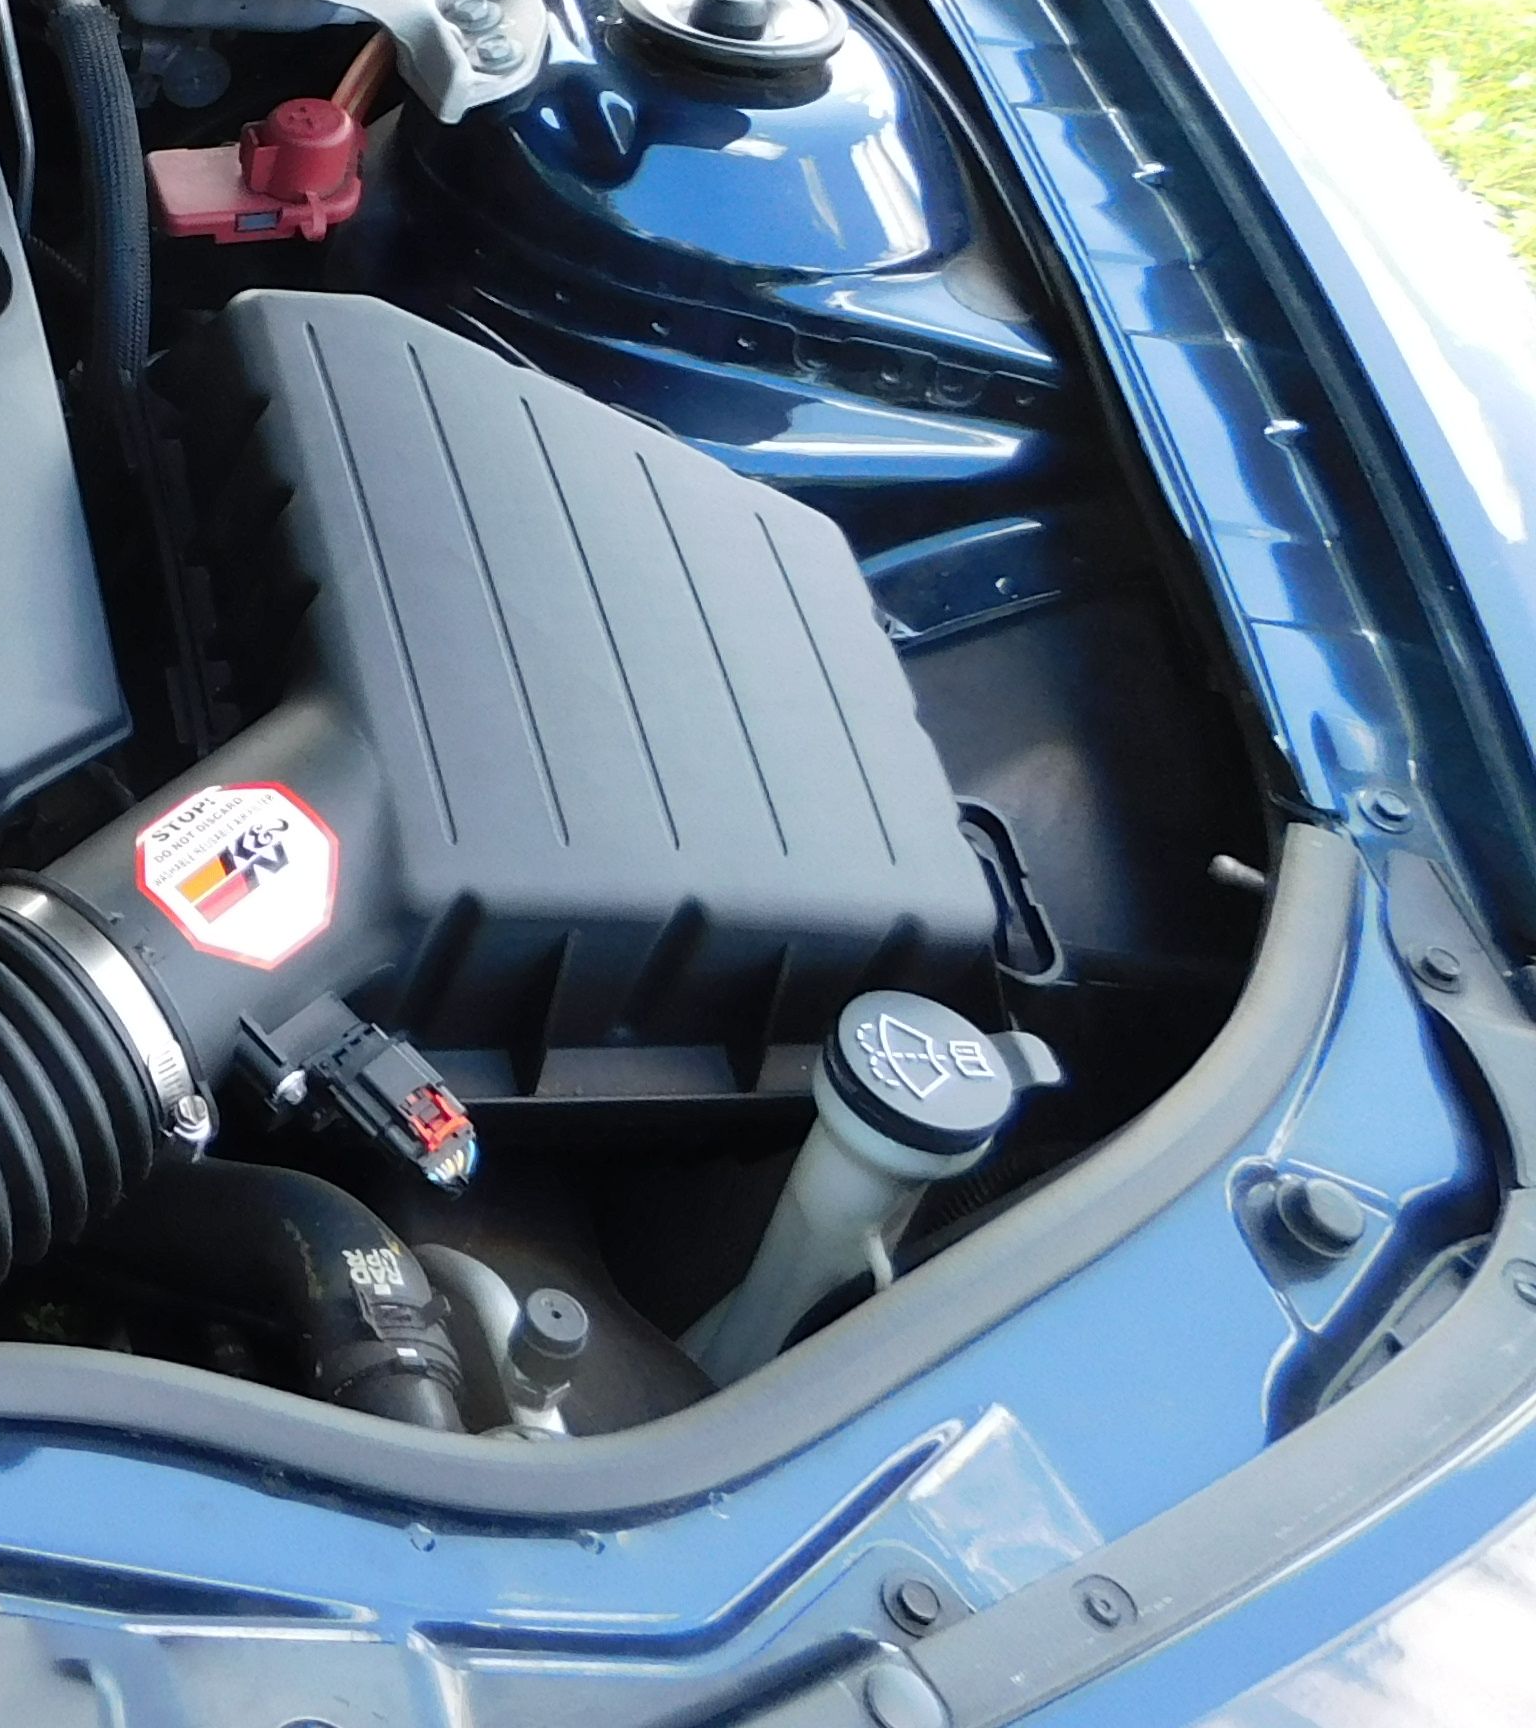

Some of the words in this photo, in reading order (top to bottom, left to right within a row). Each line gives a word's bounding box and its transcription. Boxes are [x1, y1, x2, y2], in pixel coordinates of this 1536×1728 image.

[151, 796, 217, 843] STOP!
[154, 849, 173, 864] DO
[173, 831, 196, 852] NOT
[196, 796, 244, 834] DISCARD
[217, 818, 289, 890] K&N
